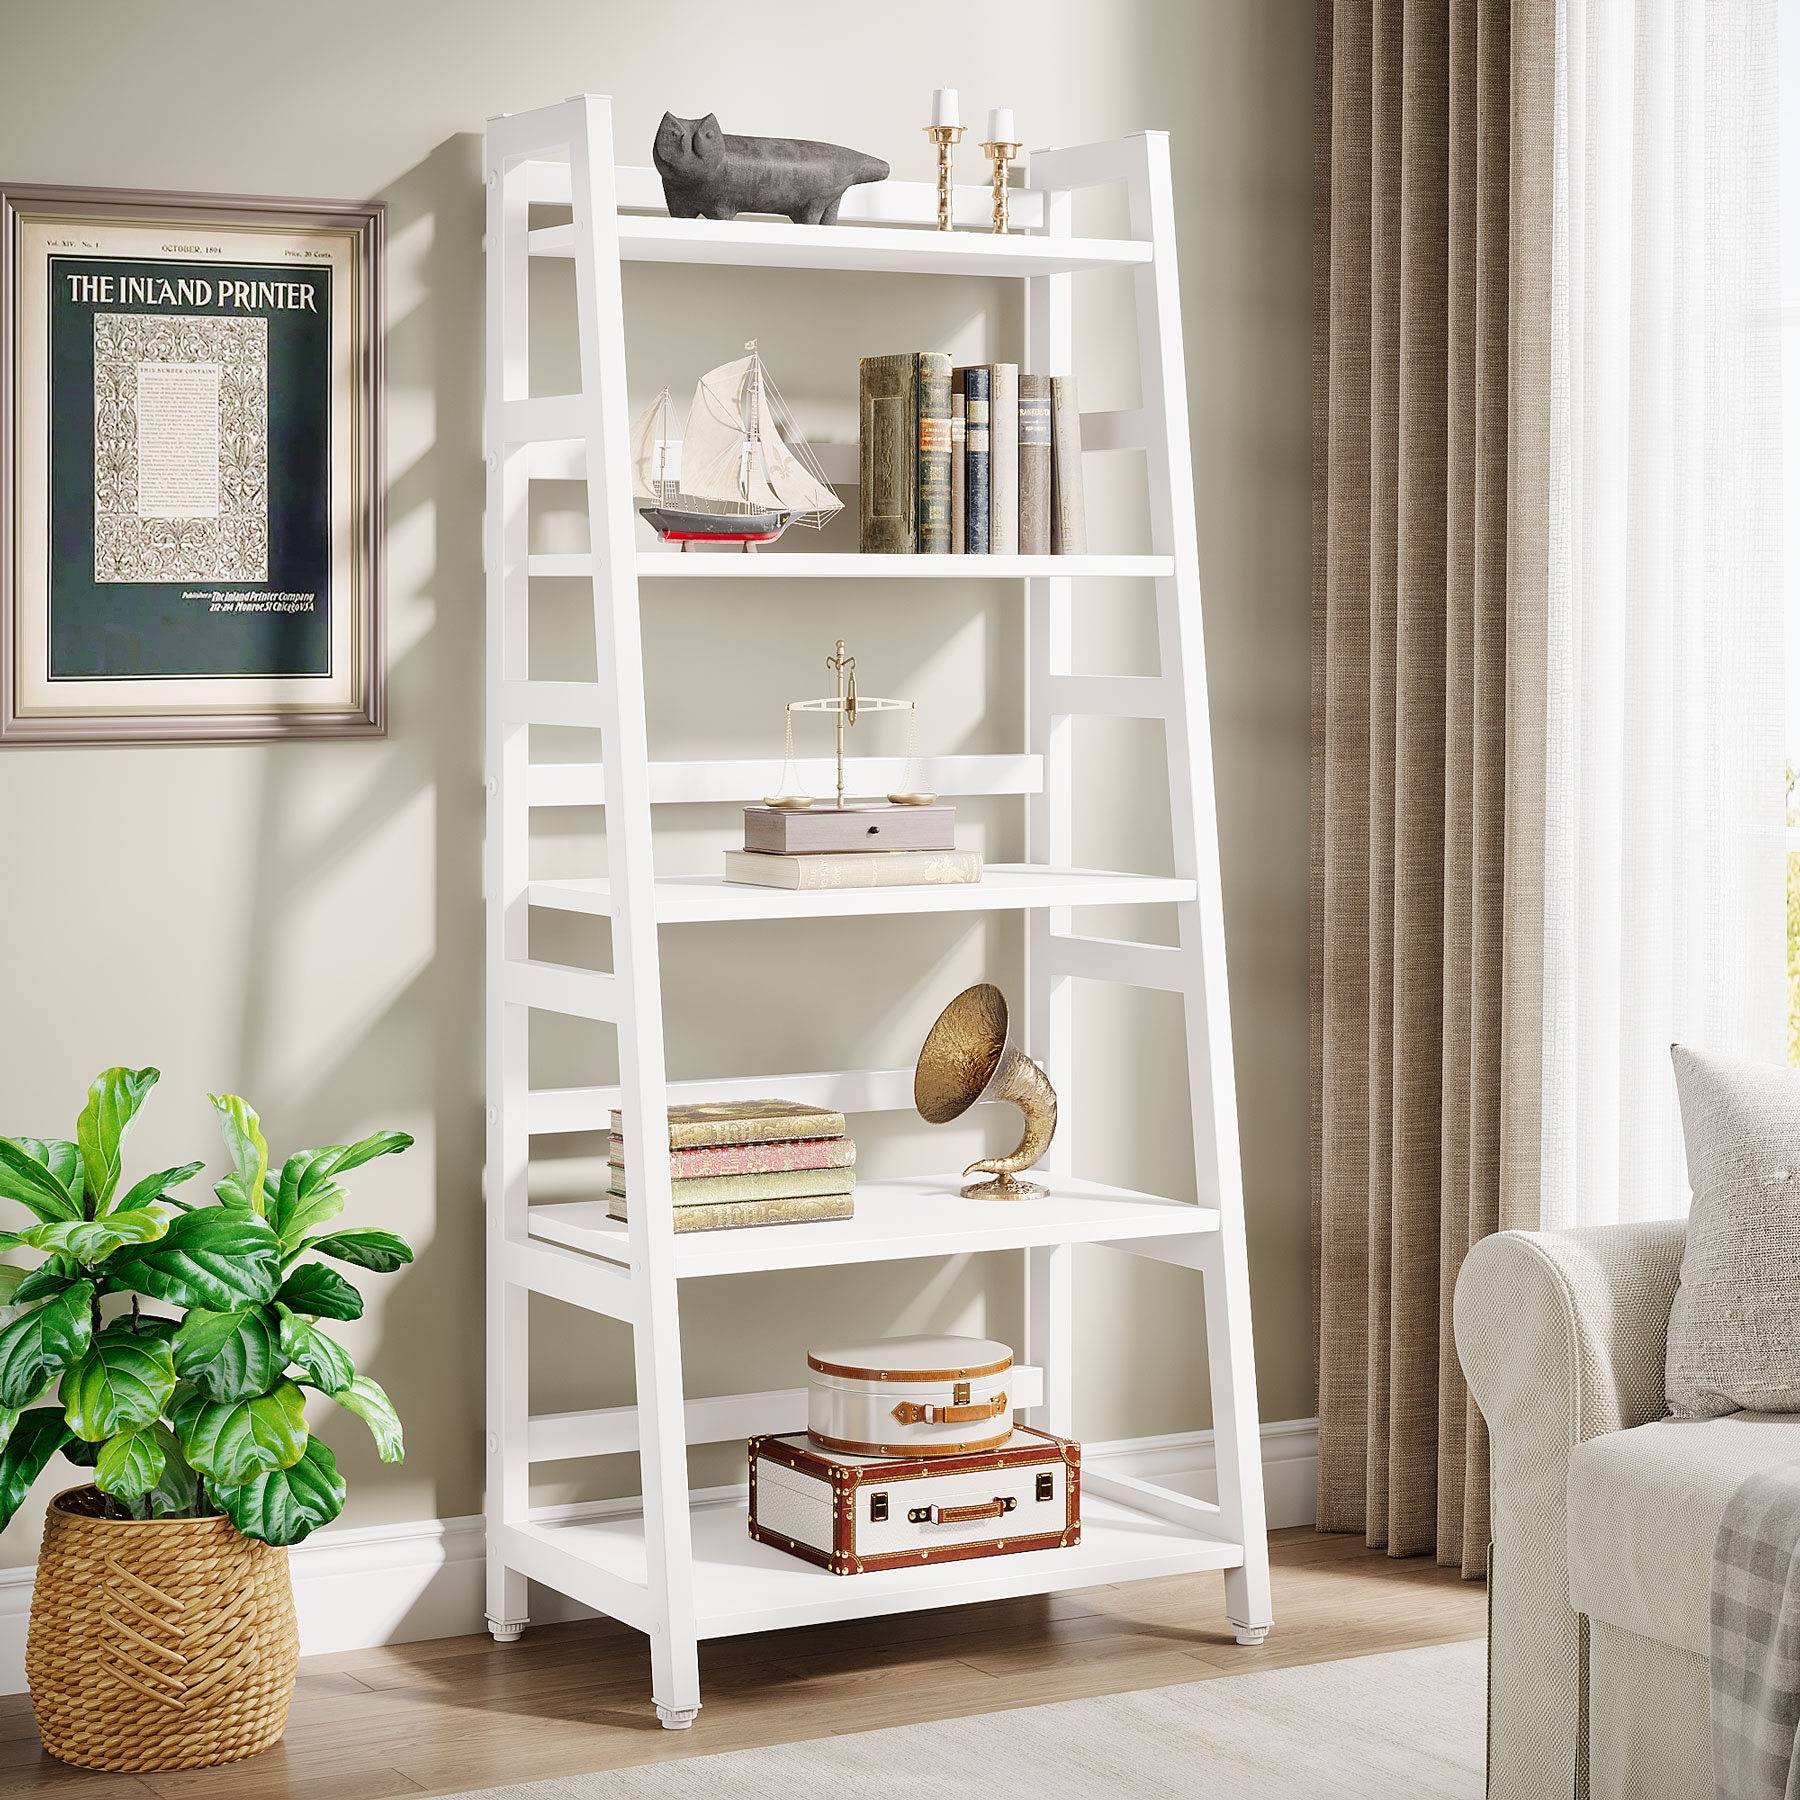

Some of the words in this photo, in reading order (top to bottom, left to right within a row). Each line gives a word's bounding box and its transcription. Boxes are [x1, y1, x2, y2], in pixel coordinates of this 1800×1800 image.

[67, 274, 114, 303] THE
[119, 276, 213, 307] INLAND
[217, 280, 318, 314] PRINTER
[211, 591, 225, 602] The
[224, 591, 250, 602] Inland
[249, 592, 279, 602] Printer
[278, 592, 315, 604] Company
[209, 603, 234, 612] 212-214
[234, 602, 265, 612] Monroe
[273, 602, 300, 614] Chicago
